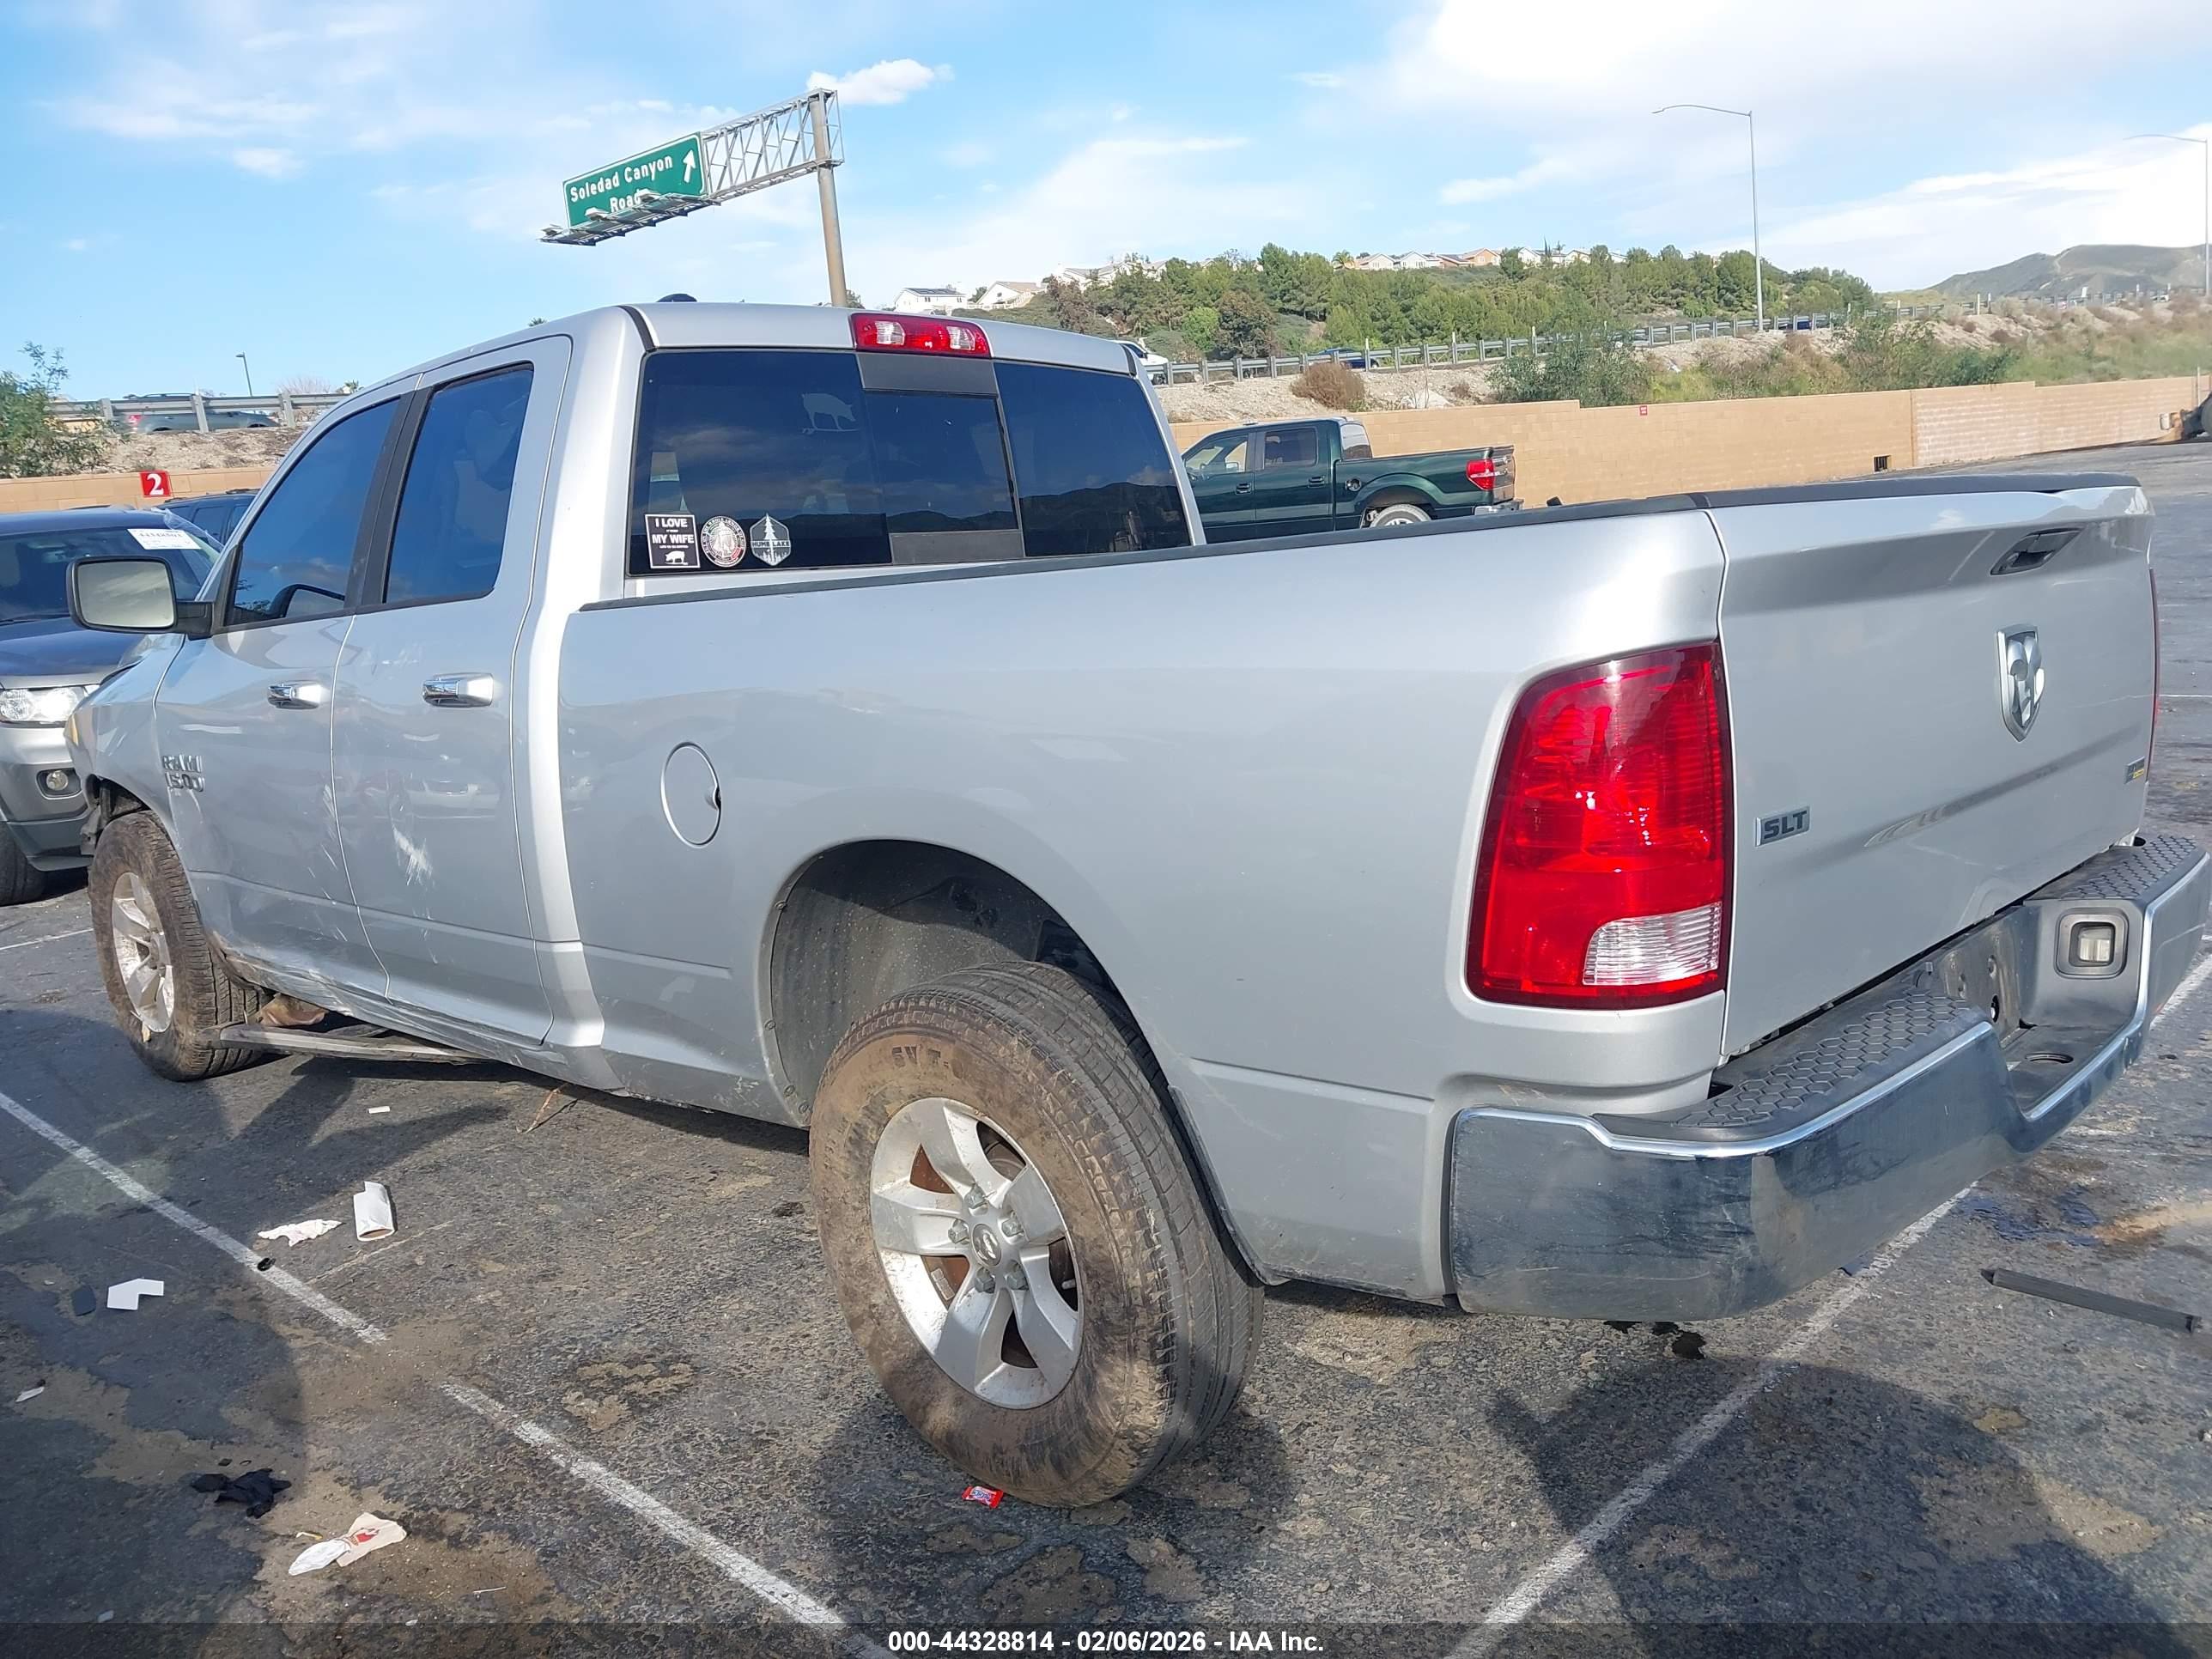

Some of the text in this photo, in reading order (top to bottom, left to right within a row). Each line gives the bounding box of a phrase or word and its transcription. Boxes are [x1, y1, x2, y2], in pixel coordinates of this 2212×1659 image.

[570, 155, 673, 203] Soledad Canyon
[610, 189, 641, 213] Road
[147, 473, 164, 495] 2
[655, 518, 688, 527] I LOVE
[652, 534, 695, 544] MY WIFE
[1764, 810, 1808, 840] SLT
